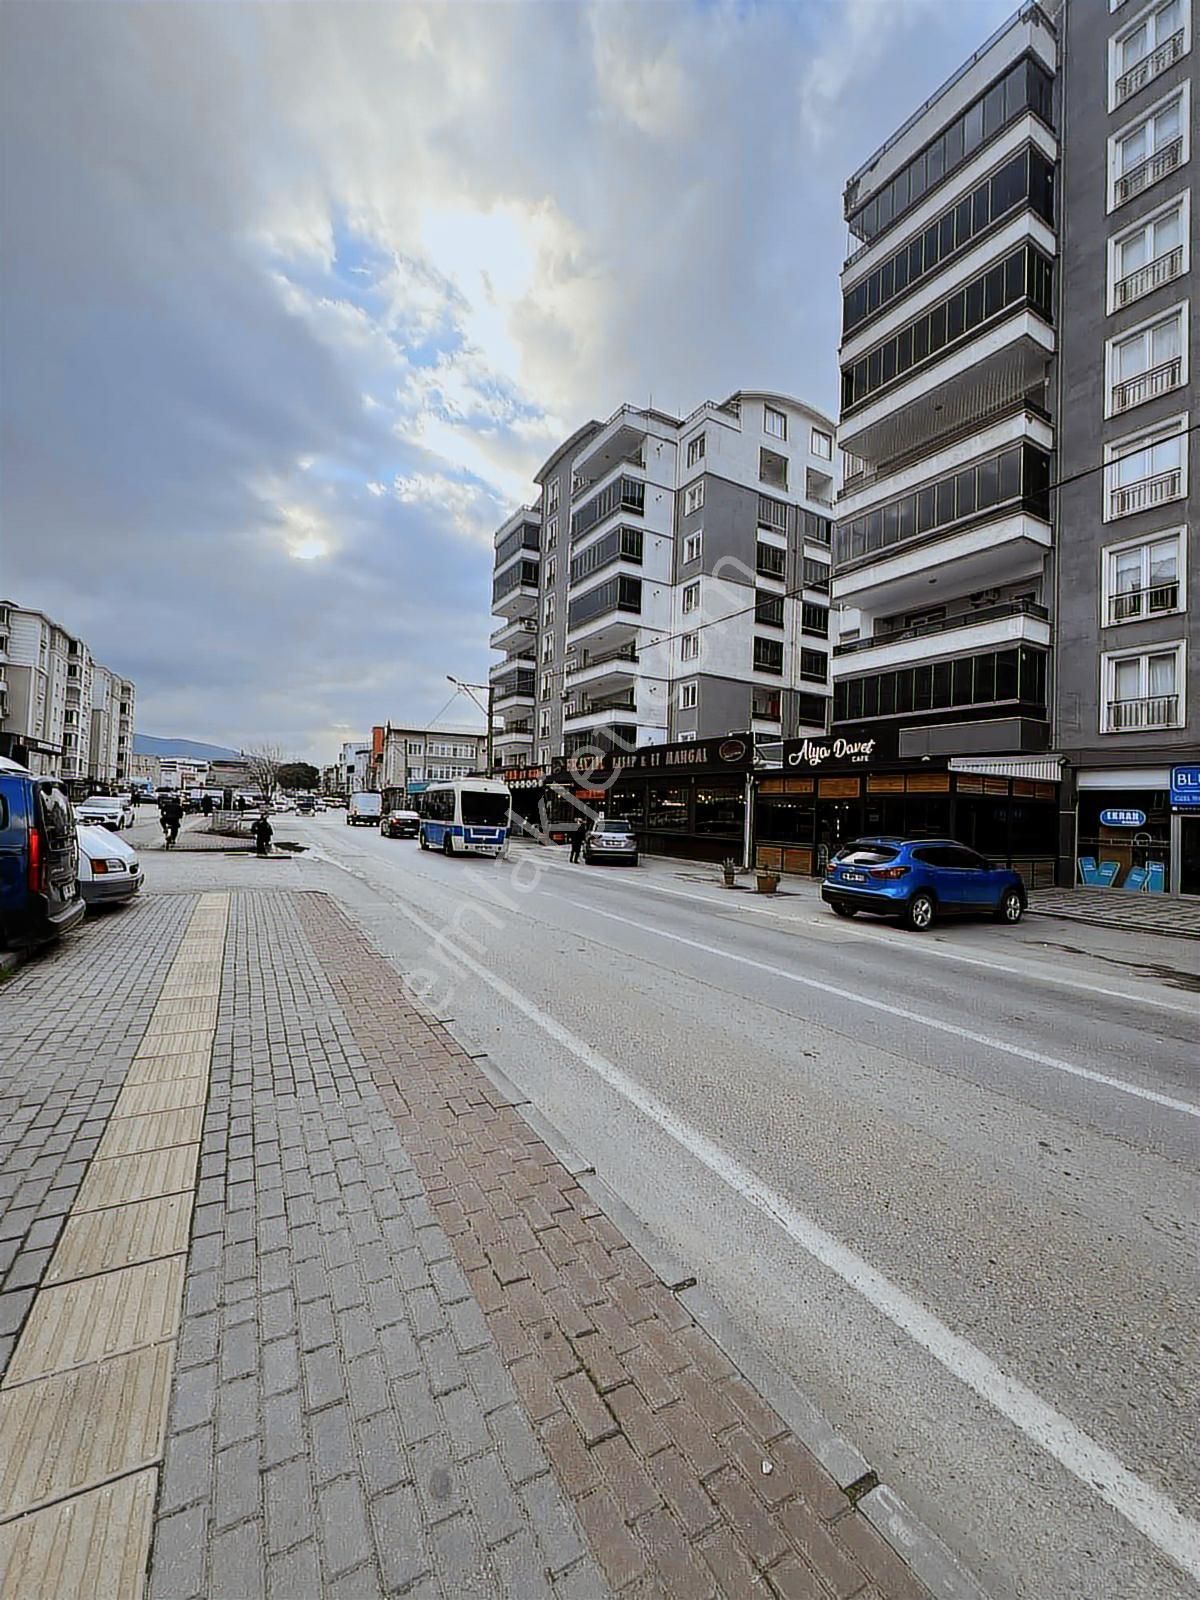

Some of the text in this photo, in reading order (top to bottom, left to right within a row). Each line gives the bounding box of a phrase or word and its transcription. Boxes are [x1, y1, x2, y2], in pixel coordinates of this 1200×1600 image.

[665, 748, 708, 766] MANGAL
[788, 738, 876, 766] Alya Davet
[1177, 773, 1200, 786] BL
